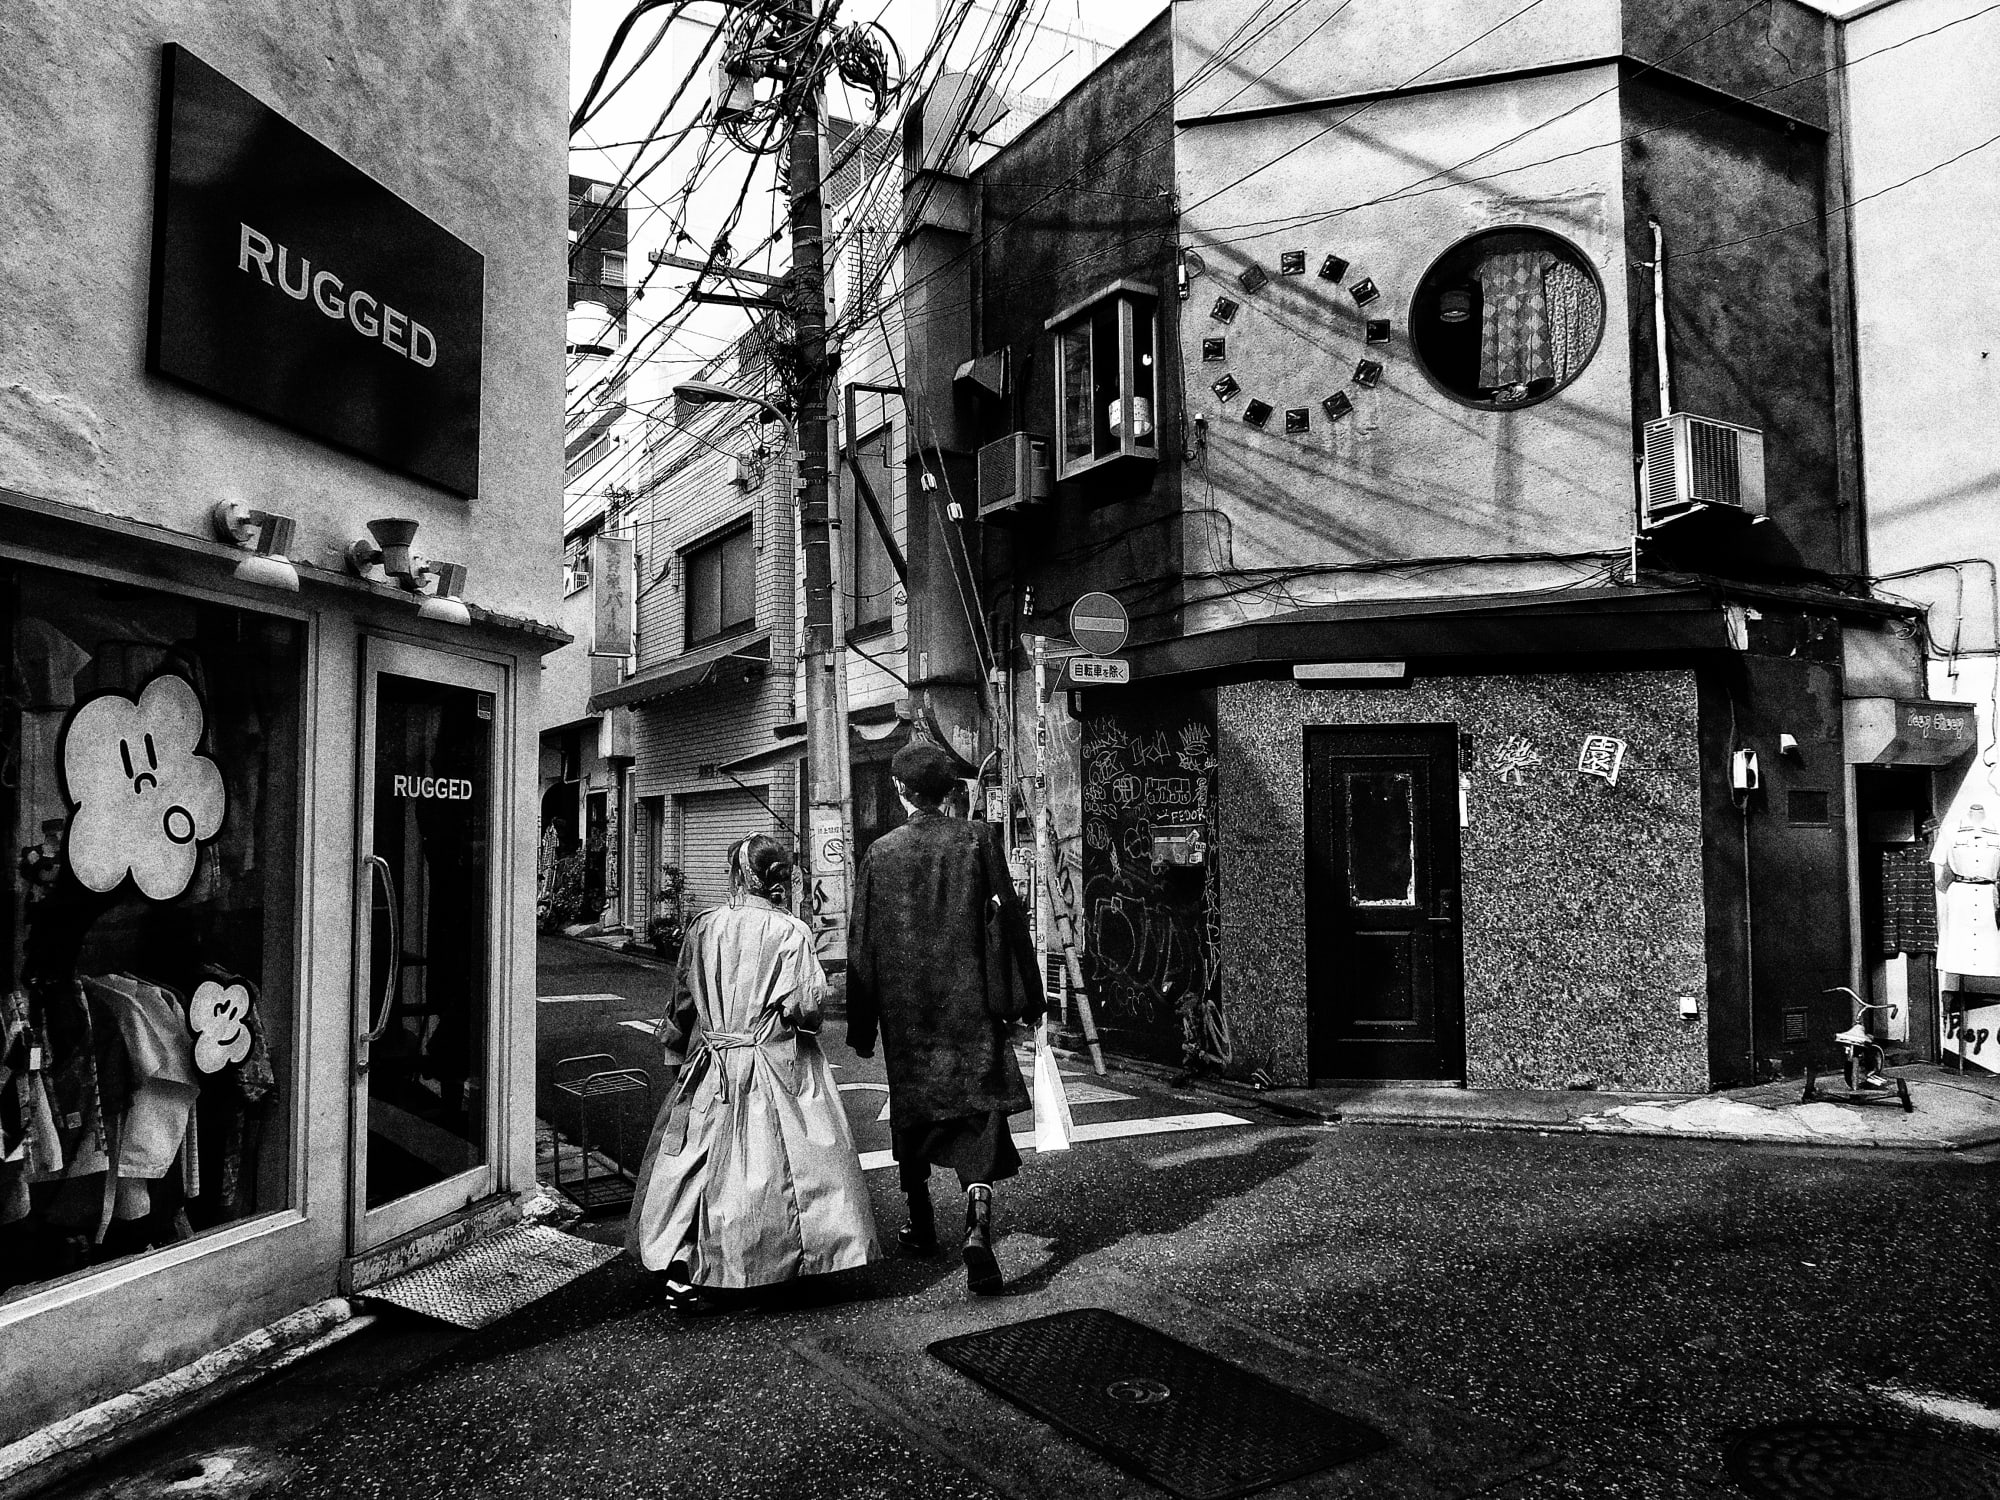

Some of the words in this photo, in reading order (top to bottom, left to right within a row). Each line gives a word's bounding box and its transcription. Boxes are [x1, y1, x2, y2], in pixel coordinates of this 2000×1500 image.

[238, 222, 437, 368] RUGGED
[1074, 664, 1124, 678] 自転車を除く
[394, 774, 472, 800] RUGGED
